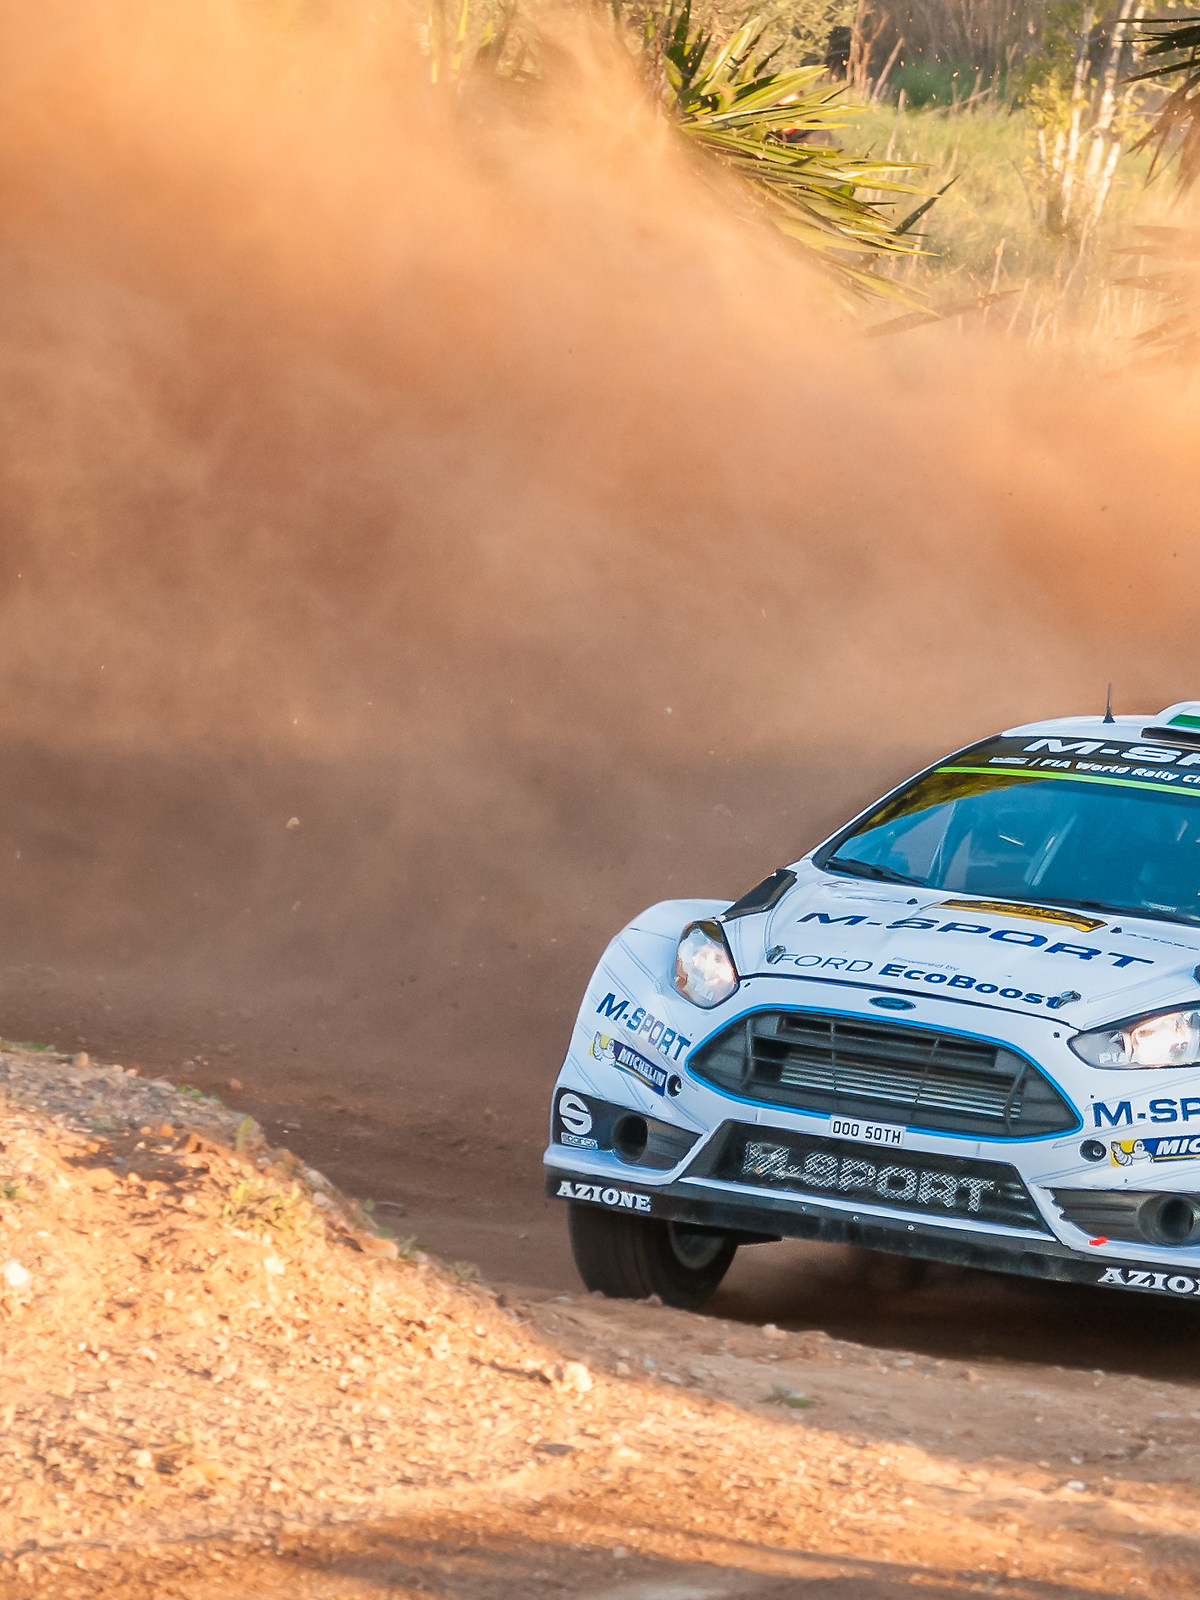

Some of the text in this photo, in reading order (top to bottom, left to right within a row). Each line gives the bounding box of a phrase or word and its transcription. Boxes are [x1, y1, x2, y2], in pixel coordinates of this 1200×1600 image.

[1040, 758, 1072, 769] FIA
[1075, 761, 1131, 775] World
[1131, 766, 1180, 782] Rally
[796, 912, 1155, 968] M-SPORT
[775, 953, 874, 973] FORD
[878, 963, 1063, 1009] EcoBoost
[596, 992, 692, 1061] M-SPORT
[618, 1048, 666, 1087] MICHELIN
[556, 1180, 652, 1212] AZIONE
[741, 1141, 996, 1212] M-SPORT
